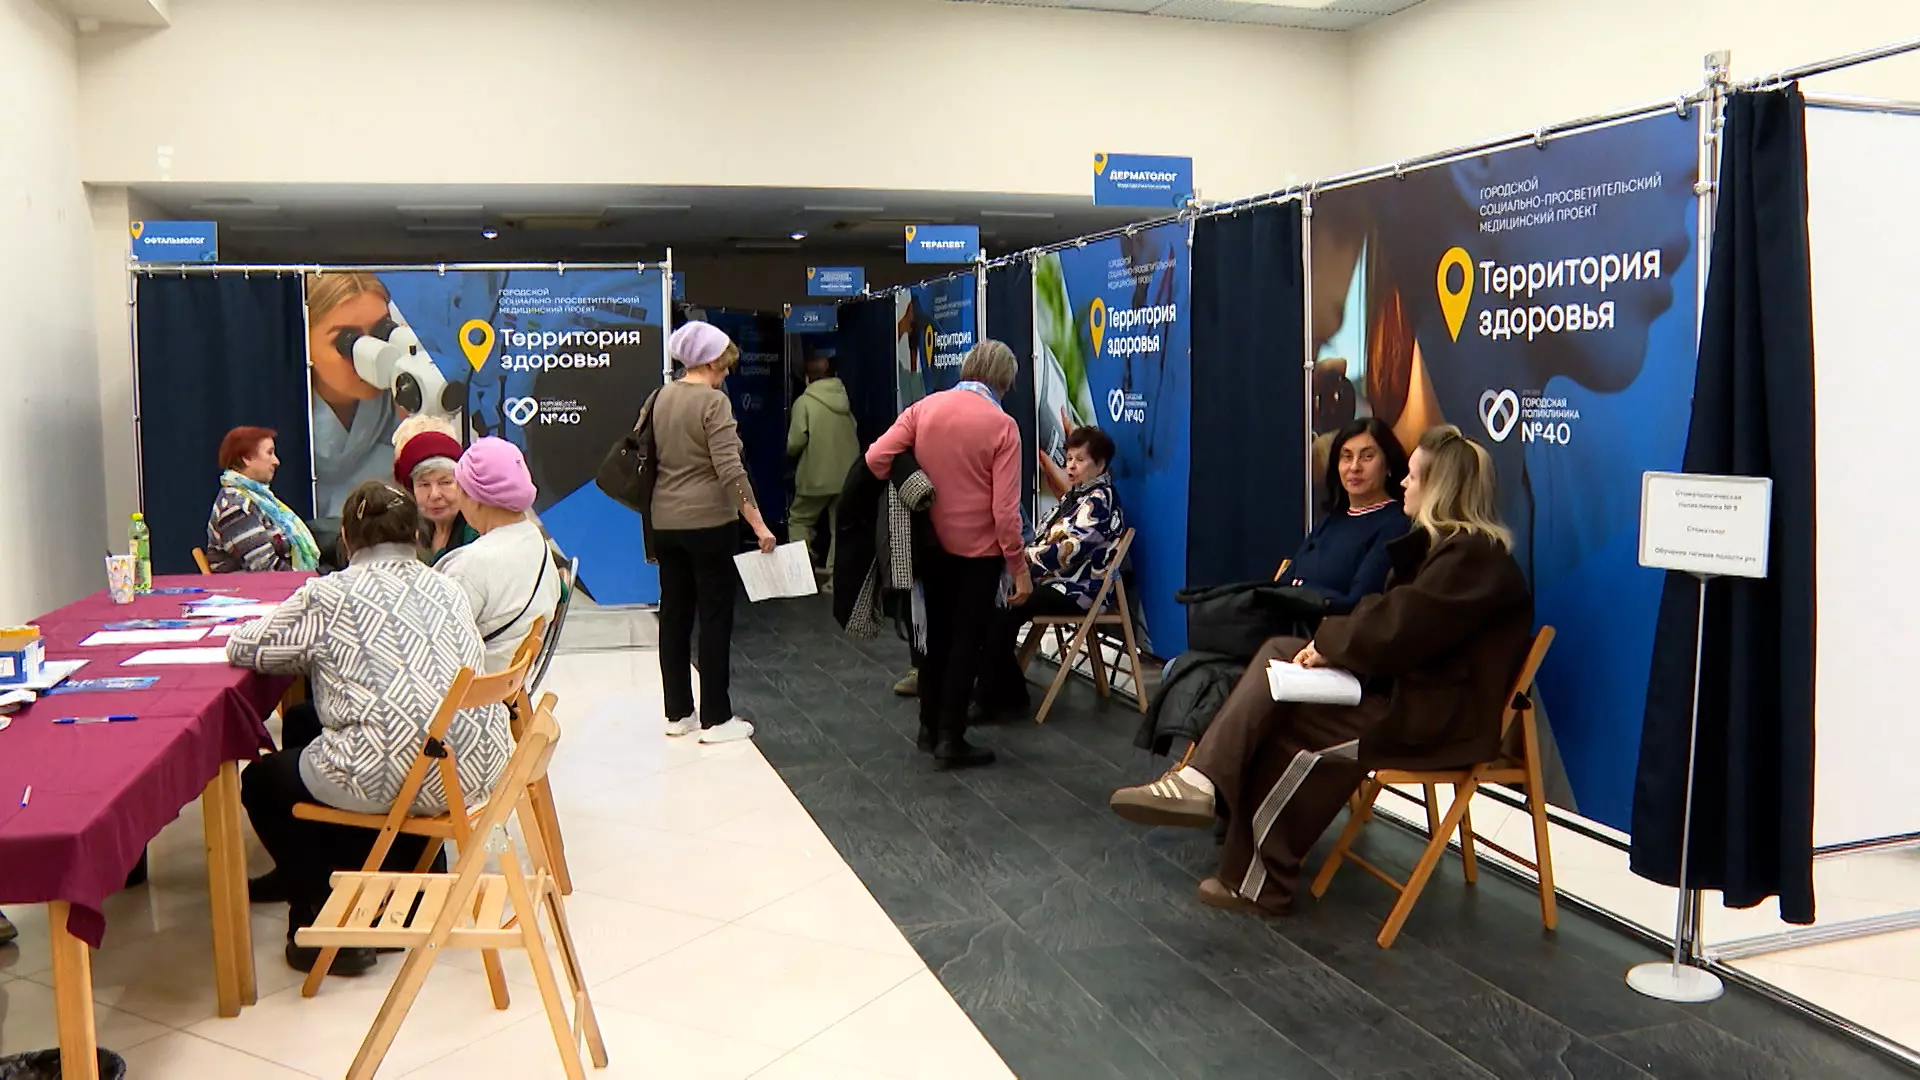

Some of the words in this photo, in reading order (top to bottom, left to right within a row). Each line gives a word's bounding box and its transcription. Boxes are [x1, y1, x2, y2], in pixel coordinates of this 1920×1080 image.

[1109, 170, 1178, 182] ДЕРМАТОЛОГ
[1479, 172, 1662, 216] СОЦИАЛЬНО-ПРОСВЕТИТЕЛЬСКИЙ
[1480, 176, 1539, 200] ГОРОДСКОЙ
[1479, 209, 1554, 233] МЕДИЦИНСКИЙ
[1556, 203, 1598, 221] ПРОЕКТ
[143, 236, 206, 245] ОФТАЛЬМОЛОГ
[919, 240, 966, 249] ТЕРАПЕВТ
[1479, 249, 1661, 299] Территория
[1107, 303, 1176, 332] Территория
[1479, 301, 1615, 341] здоровья
[500, 328, 641, 350] Территория
[934, 330, 972, 348] Территория
[1107, 334, 1160, 358] здоровья
[500, 353, 611, 372] здоровья
[1521, 397, 1567, 408] ГОРОДСКАЯ
[1521, 408, 1580, 419] ПОЛИКЛИНИКА
[1521, 421, 1571, 445] №40
